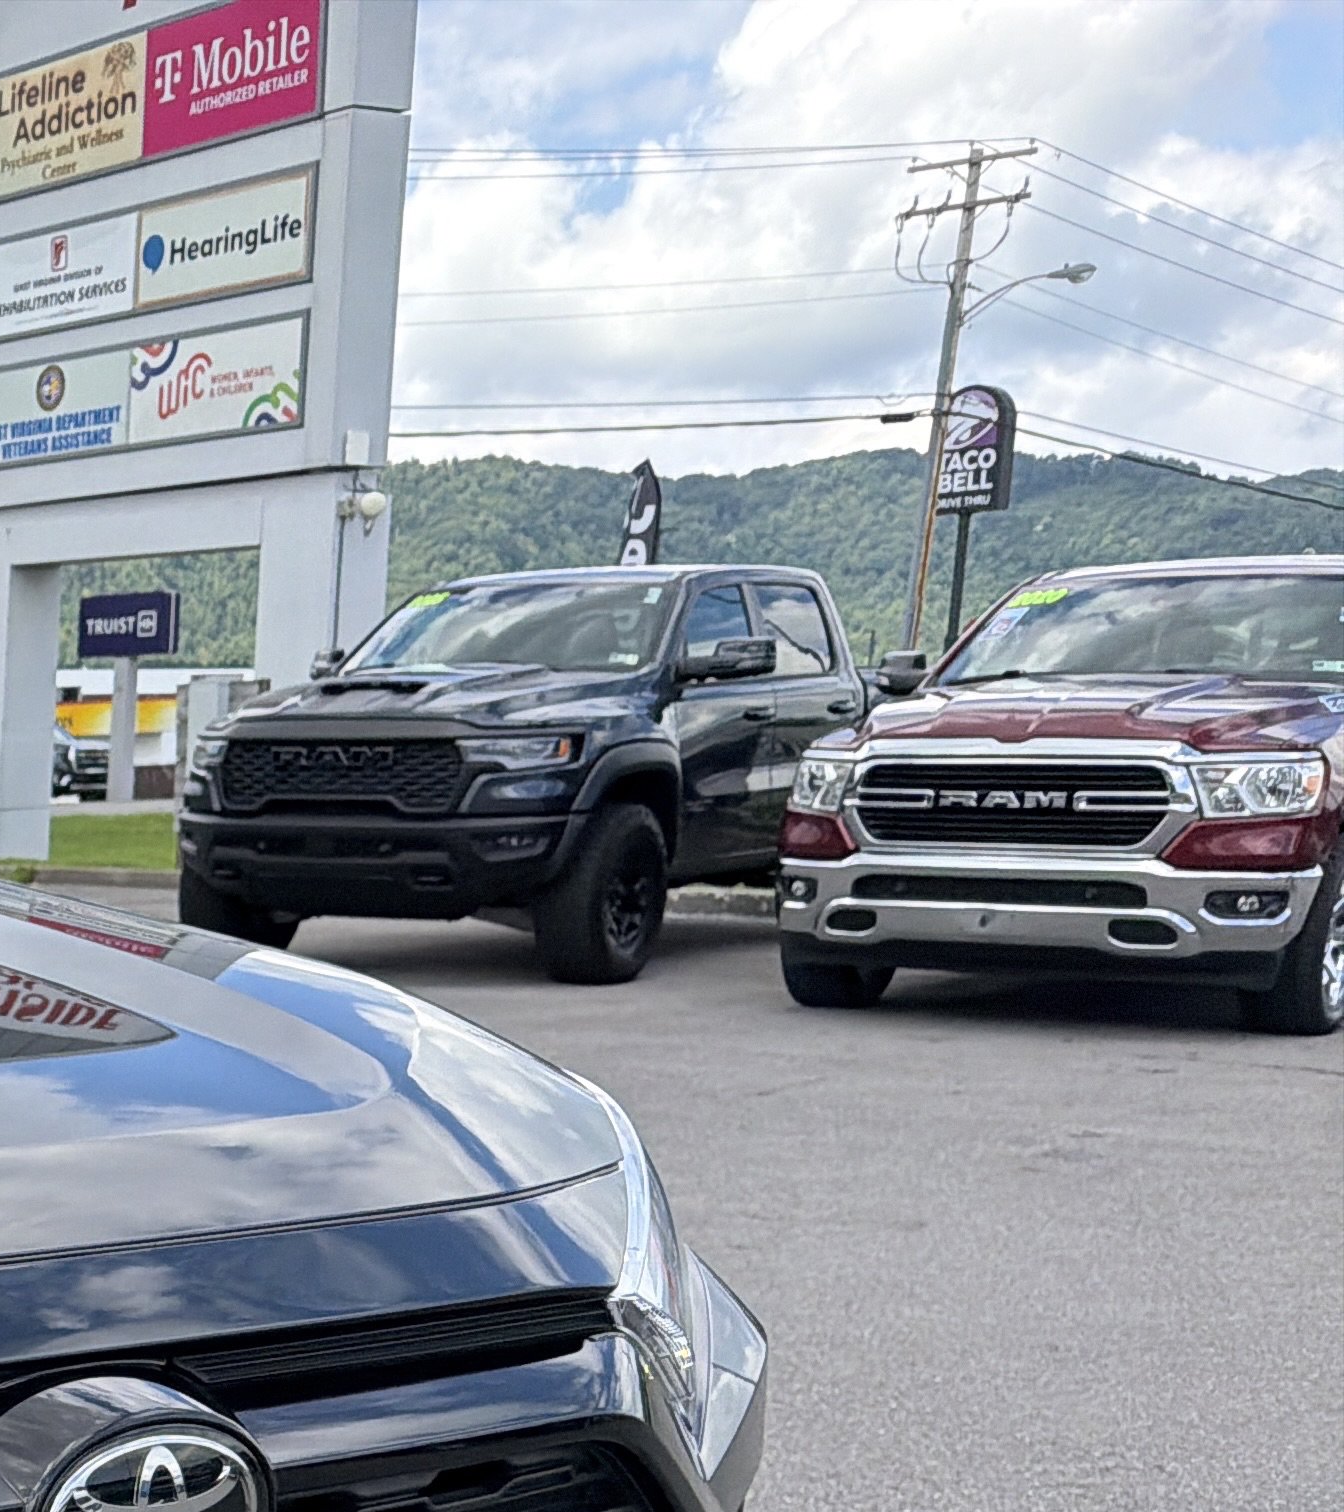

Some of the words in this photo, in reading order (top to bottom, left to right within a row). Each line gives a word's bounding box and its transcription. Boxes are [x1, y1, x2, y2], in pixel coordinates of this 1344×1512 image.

[189, 84, 257, 116] AUTHORIZED
[258, 69, 309, 96] RETAILER
[13, 90, 137, 147] Addiction
[0, 146, 53, 176] Psychiatric
[55, 136, 75, 156] and
[76, 128, 125, 150] Wellness
[42, 161, 78, 180] Center
[169, 213, 302, 265] HearingLife
[78, 277, 128, 302] SERVICES
[941, 448, 997, 472] TACO
[938, 469, 994, 494] BELL
[86, 616, 136, 636] TRUIST
[939, 791, 1068, 808] RAM
